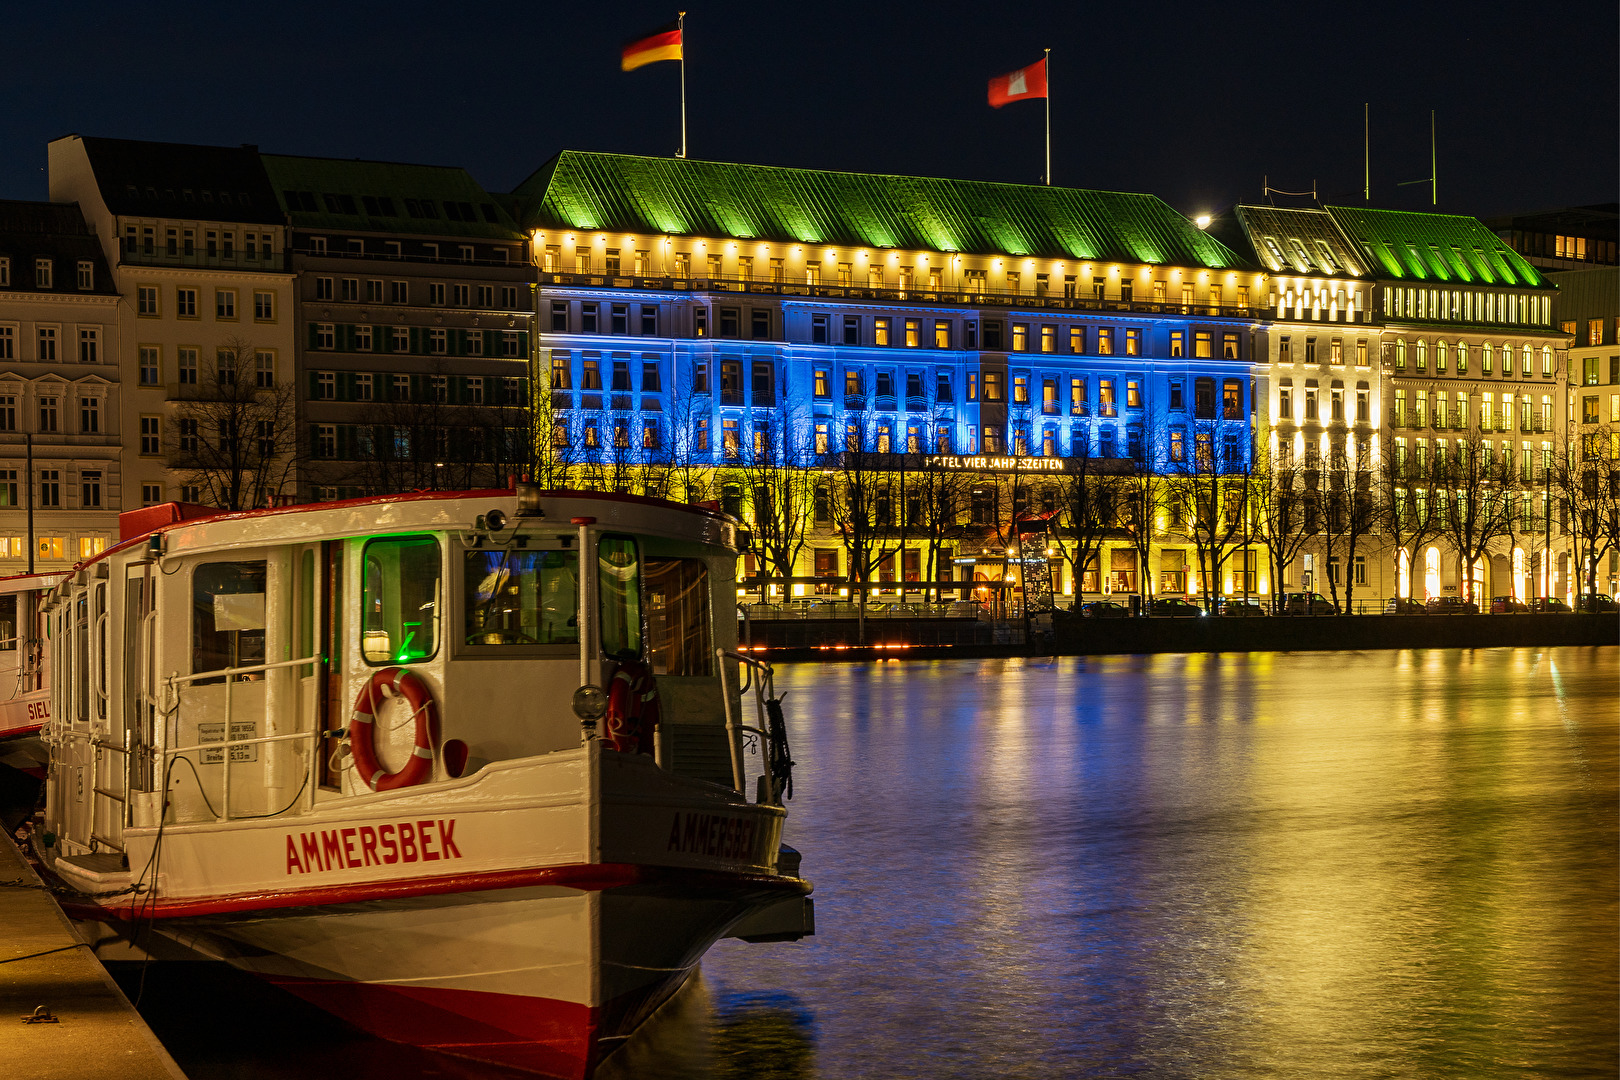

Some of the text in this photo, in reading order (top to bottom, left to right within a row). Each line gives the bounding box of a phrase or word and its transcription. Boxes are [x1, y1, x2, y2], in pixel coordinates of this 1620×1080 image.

[963, 457, 987, 468] VIER
[988, 458, 1063, 470] JAHRESZEITEN
[28, 700, 51, 720] SIEL
[286, 819, 462, 874] AMMERSBEK
